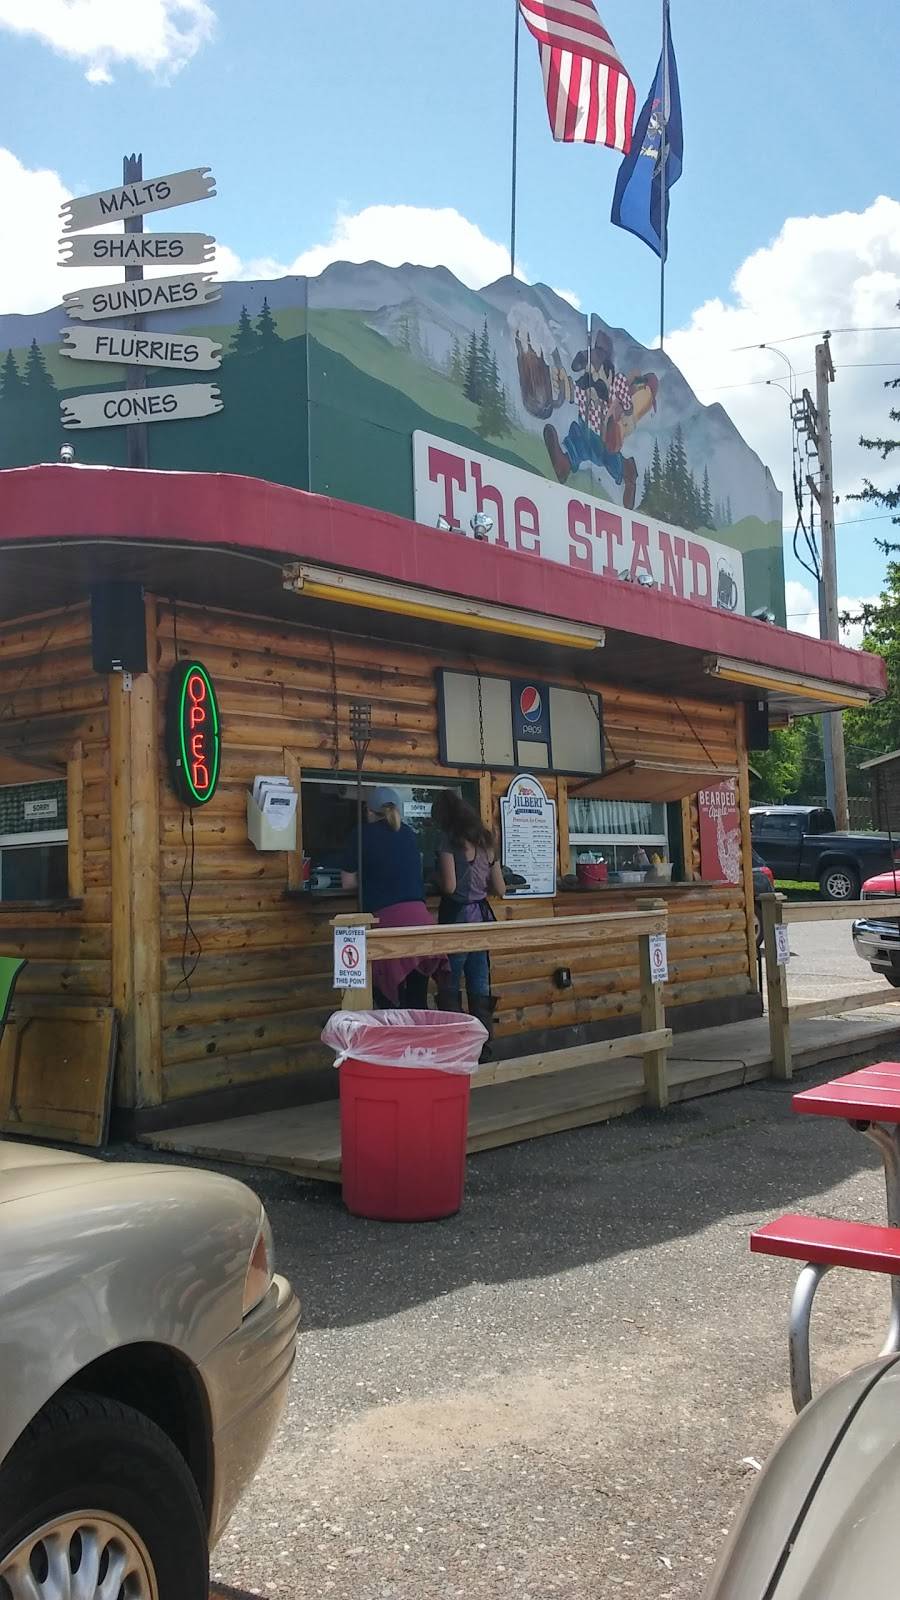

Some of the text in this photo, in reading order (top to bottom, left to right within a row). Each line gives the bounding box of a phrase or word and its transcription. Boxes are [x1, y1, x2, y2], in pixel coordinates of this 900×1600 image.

[99, 181, 171, 216] MALTS
[93, 239, 184, 259] SHAKES
[92, 282, 198, 313] SUNDAES
[95, 336, 199, 362] FLURRIES
[103, 393, 178, 419] CONES
[428, 446, 712, 602] The STAND
[189, 675, 209, 789] OPEN
[522, 724, 542, 736] pepsi
[512, 794, 544, 809] JILBERT
[700, 790, 736, 806] BEARDED
